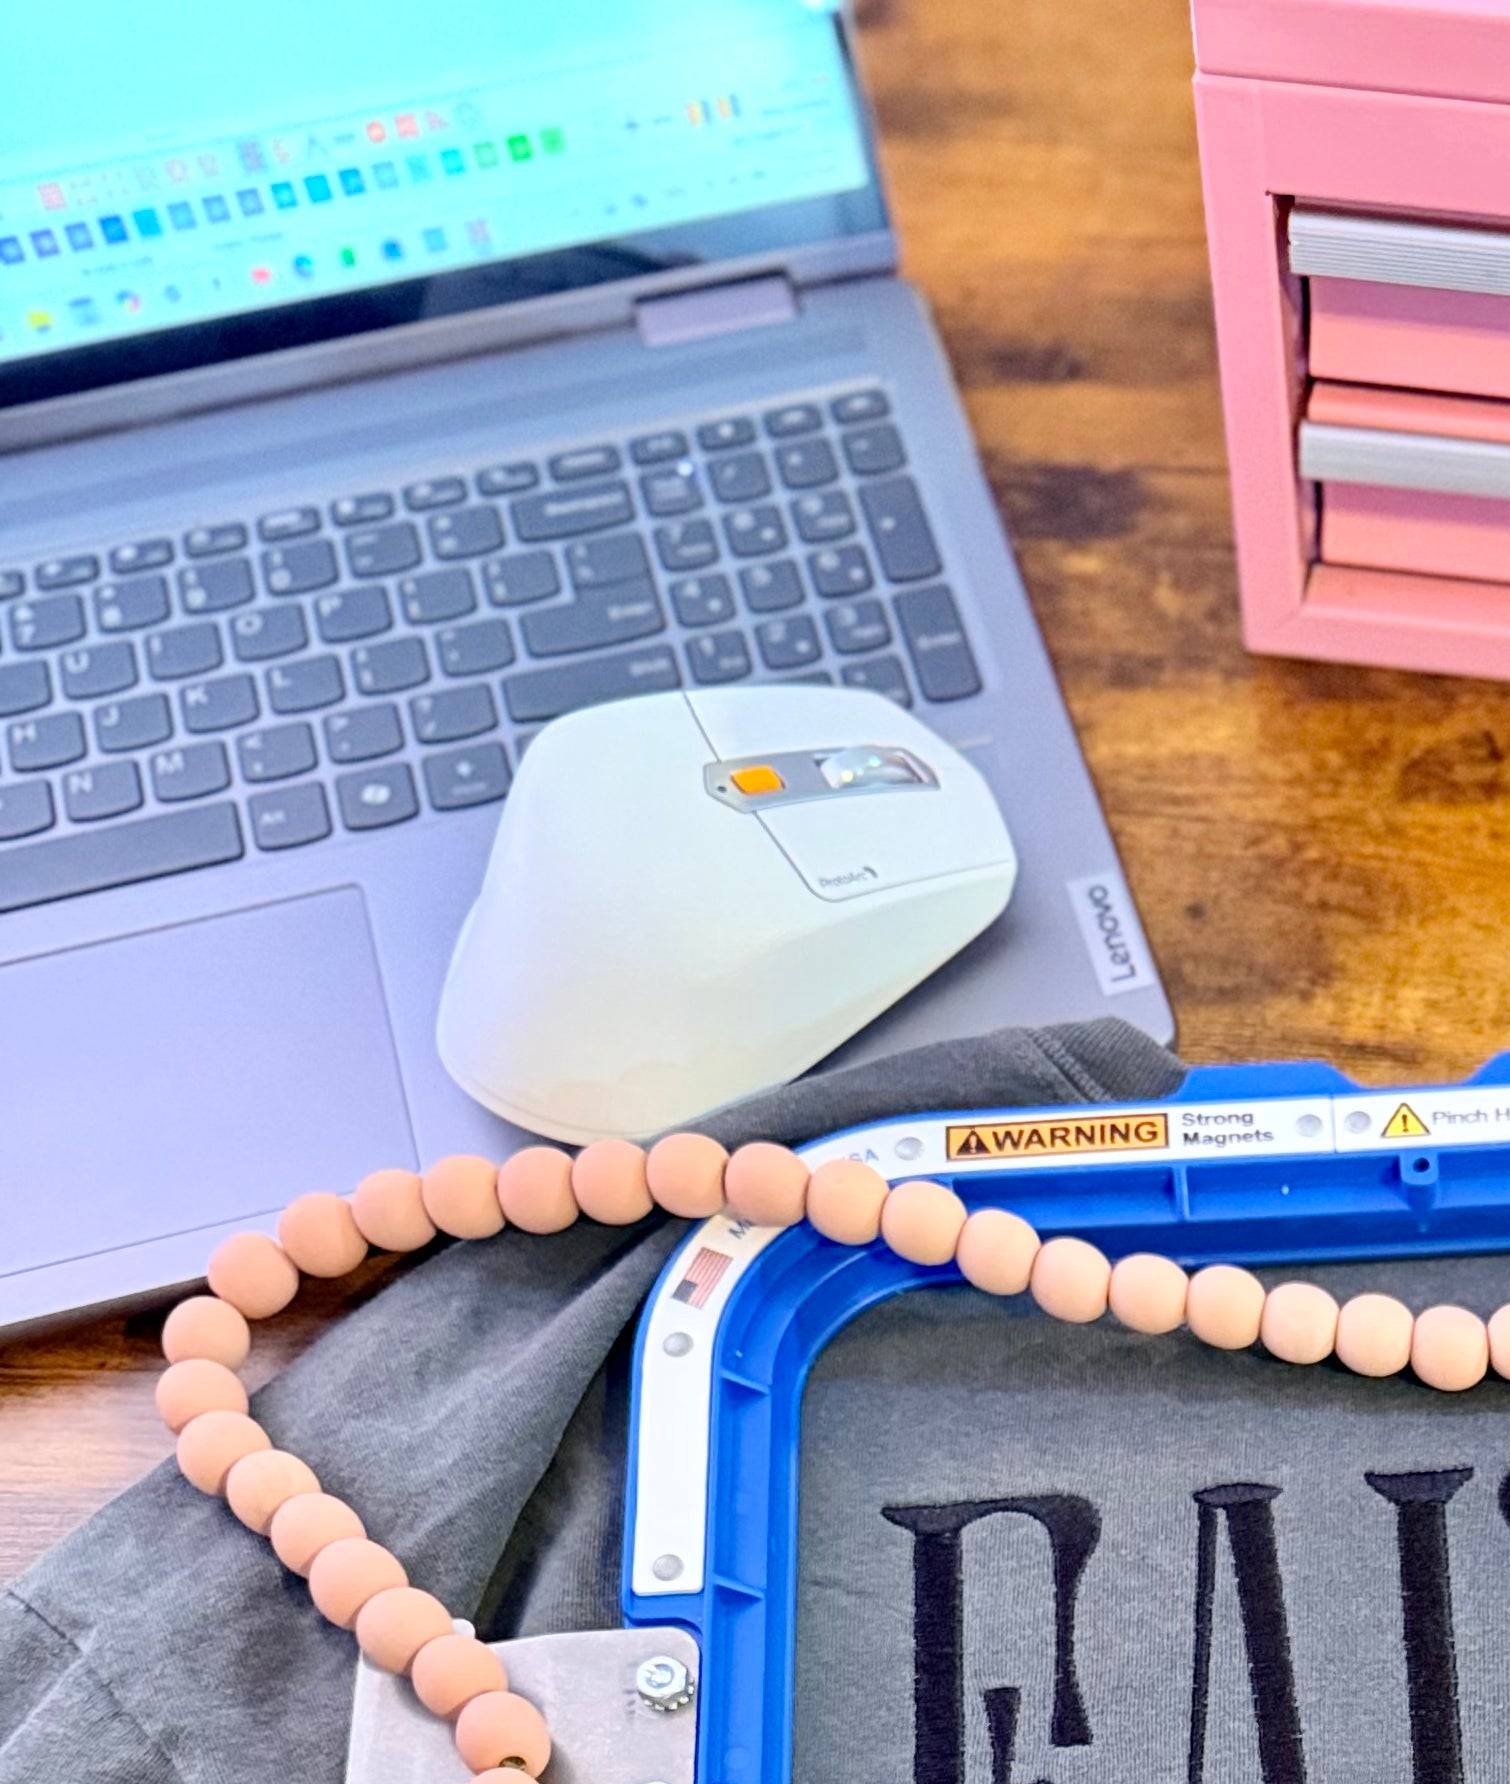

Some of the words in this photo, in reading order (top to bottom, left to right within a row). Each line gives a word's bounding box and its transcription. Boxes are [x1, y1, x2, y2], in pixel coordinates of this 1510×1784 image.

[235, 614, 263, 635] O
[64, 651, 90, 674] U
[270, 669, 290, 688] L
[102, 706, 120, 727] J
[13, 724, 37, 743] H
[154, 752, 184, 774] M
[68, 772, 93, 794] N
[1088, 885, 1136, 982] Lenovo
[1182, 1112, 1254, 1128] Strong
[1432, 1109, 1488, 1126] Pinch
[993, 1121, 1158, 1151] WARNING
[1182, 1129, 1274, 1147] Magnets
